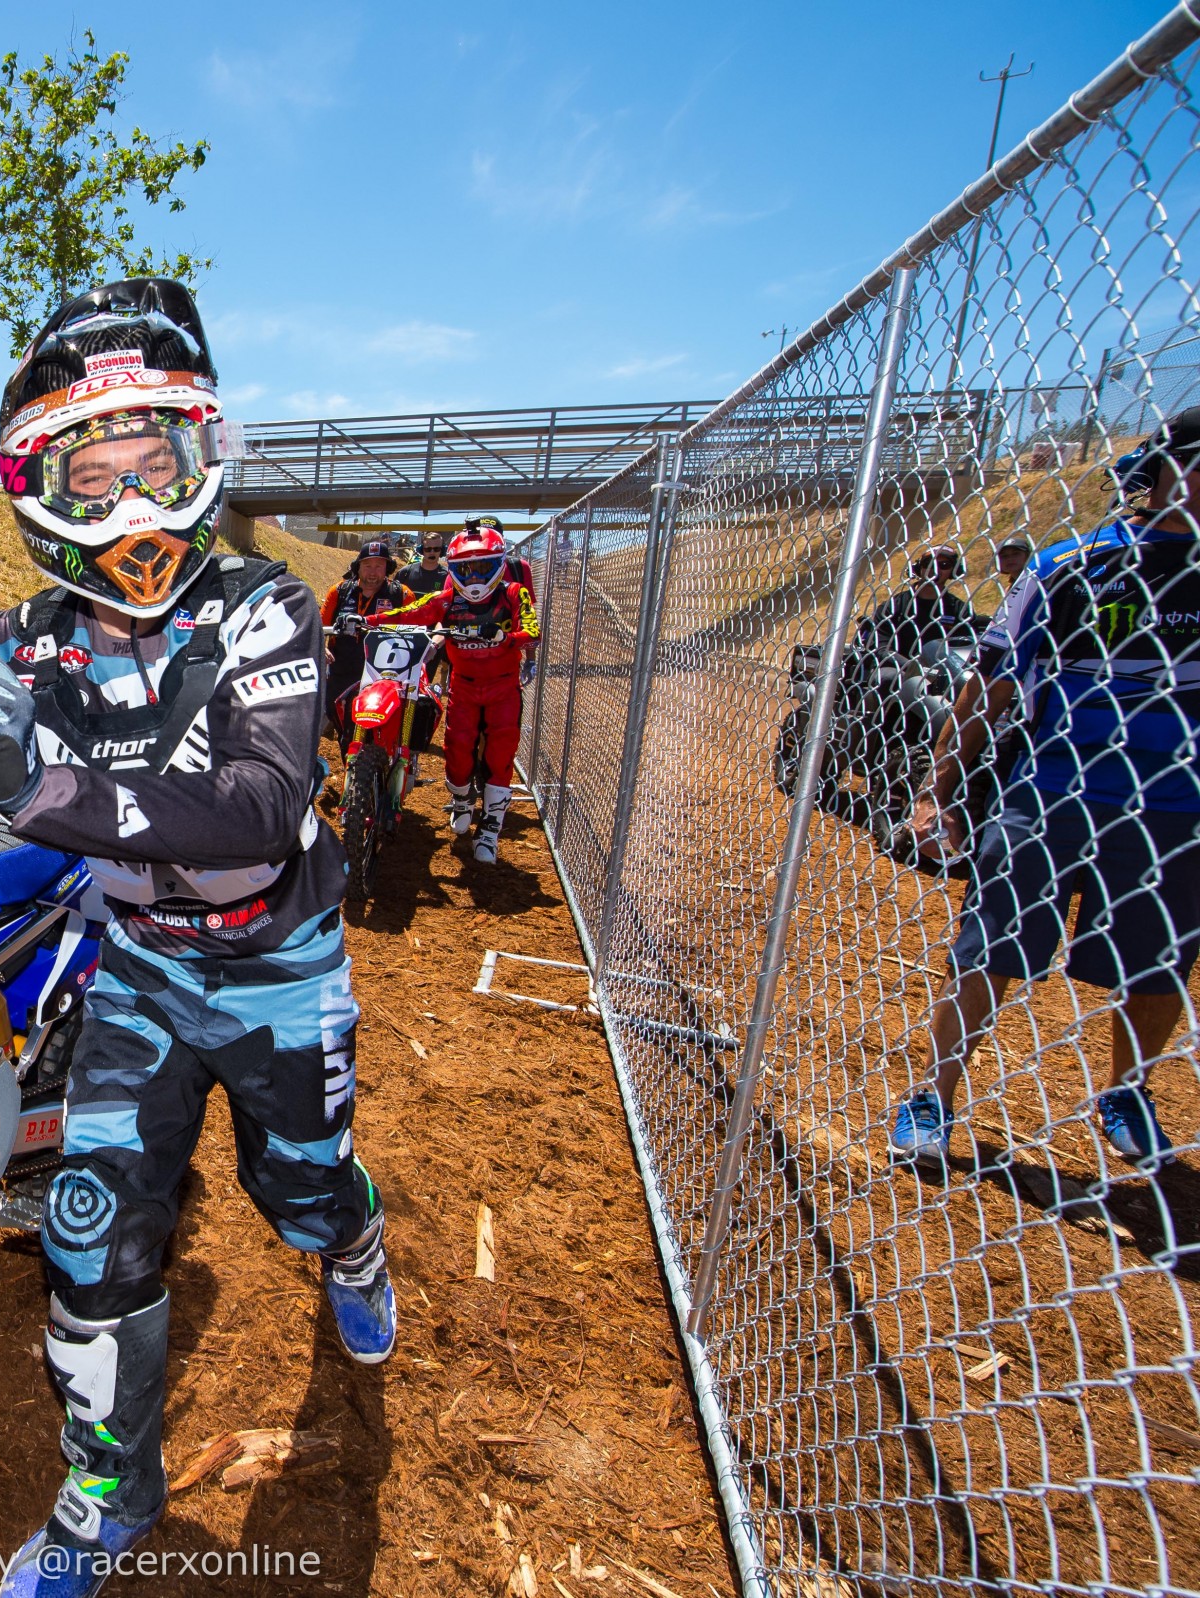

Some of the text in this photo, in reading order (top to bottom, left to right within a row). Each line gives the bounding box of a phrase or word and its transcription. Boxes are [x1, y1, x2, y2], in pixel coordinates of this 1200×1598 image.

[86, 355, 142, 372] ESCONDIDO
[128, 515, 155, 527] BELL
[20, 527, 60, 560] NSTER
[373, 637, 415, 669] 6
[355, 712, 385, 720] GEICO
[91, 737, 158, 759] thor
[221, 898, 268, 928] YAMAHA
[247, 914, 274, 936] SERVICES
